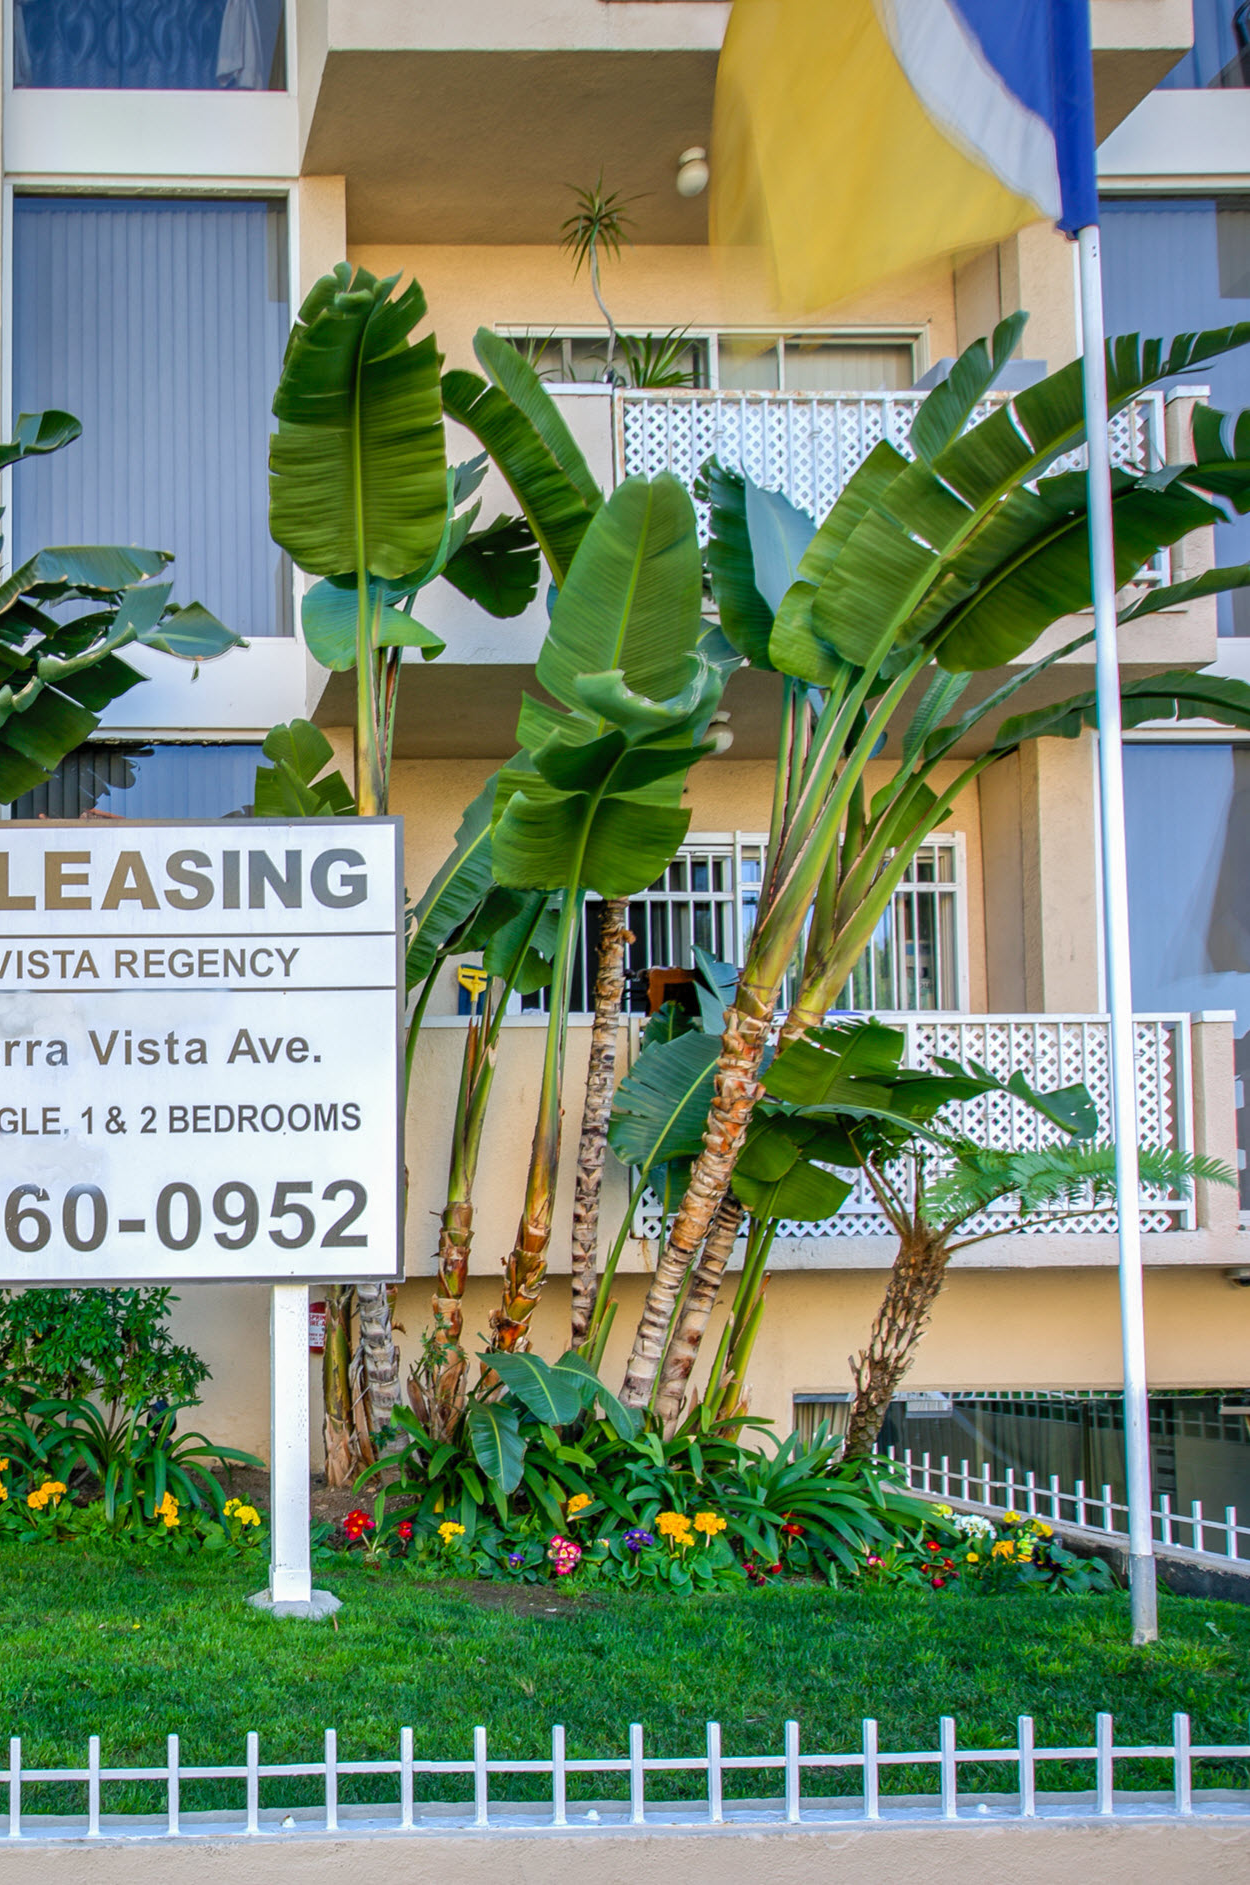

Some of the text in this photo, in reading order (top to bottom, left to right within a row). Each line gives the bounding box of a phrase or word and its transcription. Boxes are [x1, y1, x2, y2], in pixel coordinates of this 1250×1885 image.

[115, 948, 300, 979] REGENCY
[88, 1030, 208, 1066] Vista
[226, 1028, 321, 1064] Ave.
[81, 1106, 93, 1135] 1
[105, 1105, 128, 1135] &
[140, 1105, 157, 1134] 2
[169, 1102, 361, 1134] BEDROOMS
